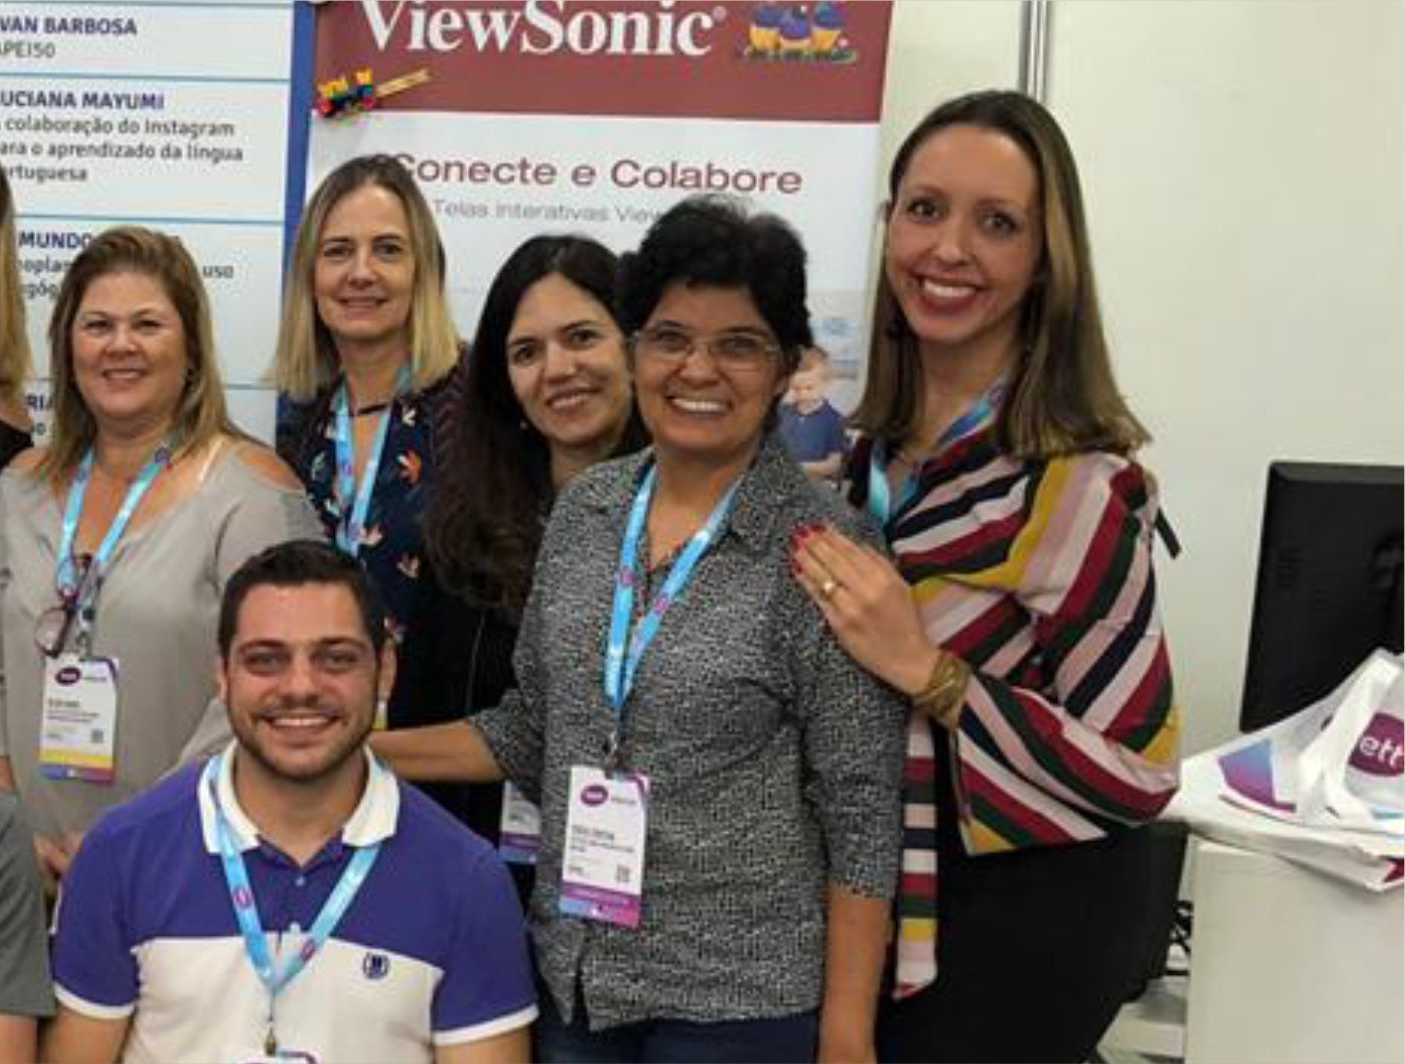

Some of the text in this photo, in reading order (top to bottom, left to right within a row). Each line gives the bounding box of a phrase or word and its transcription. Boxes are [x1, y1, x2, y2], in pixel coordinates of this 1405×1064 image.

[44, 17, 138, 36] BARBOSA
[358, 0, 714, 56] ViewSonic
[82, 92, 164, 110] MAYUMI
[5, 116, 113, 136] colaboração
[118, 118, 140, 134] do
[145, 119, 235, 140] Instagram
[31, 143, 42, 155] o
[47, 141, 155, 162] aprendizado
[160, 143, 182, 159] da
[187, 143, 244, 163] língua
[571, 166, 595, 187] e
[610, 158, 803, 194] Colabore
[432, 198, 489, 218] Telas
[495, 201, 609, 224] Interativas
[202, 265, 234, 279] uso
